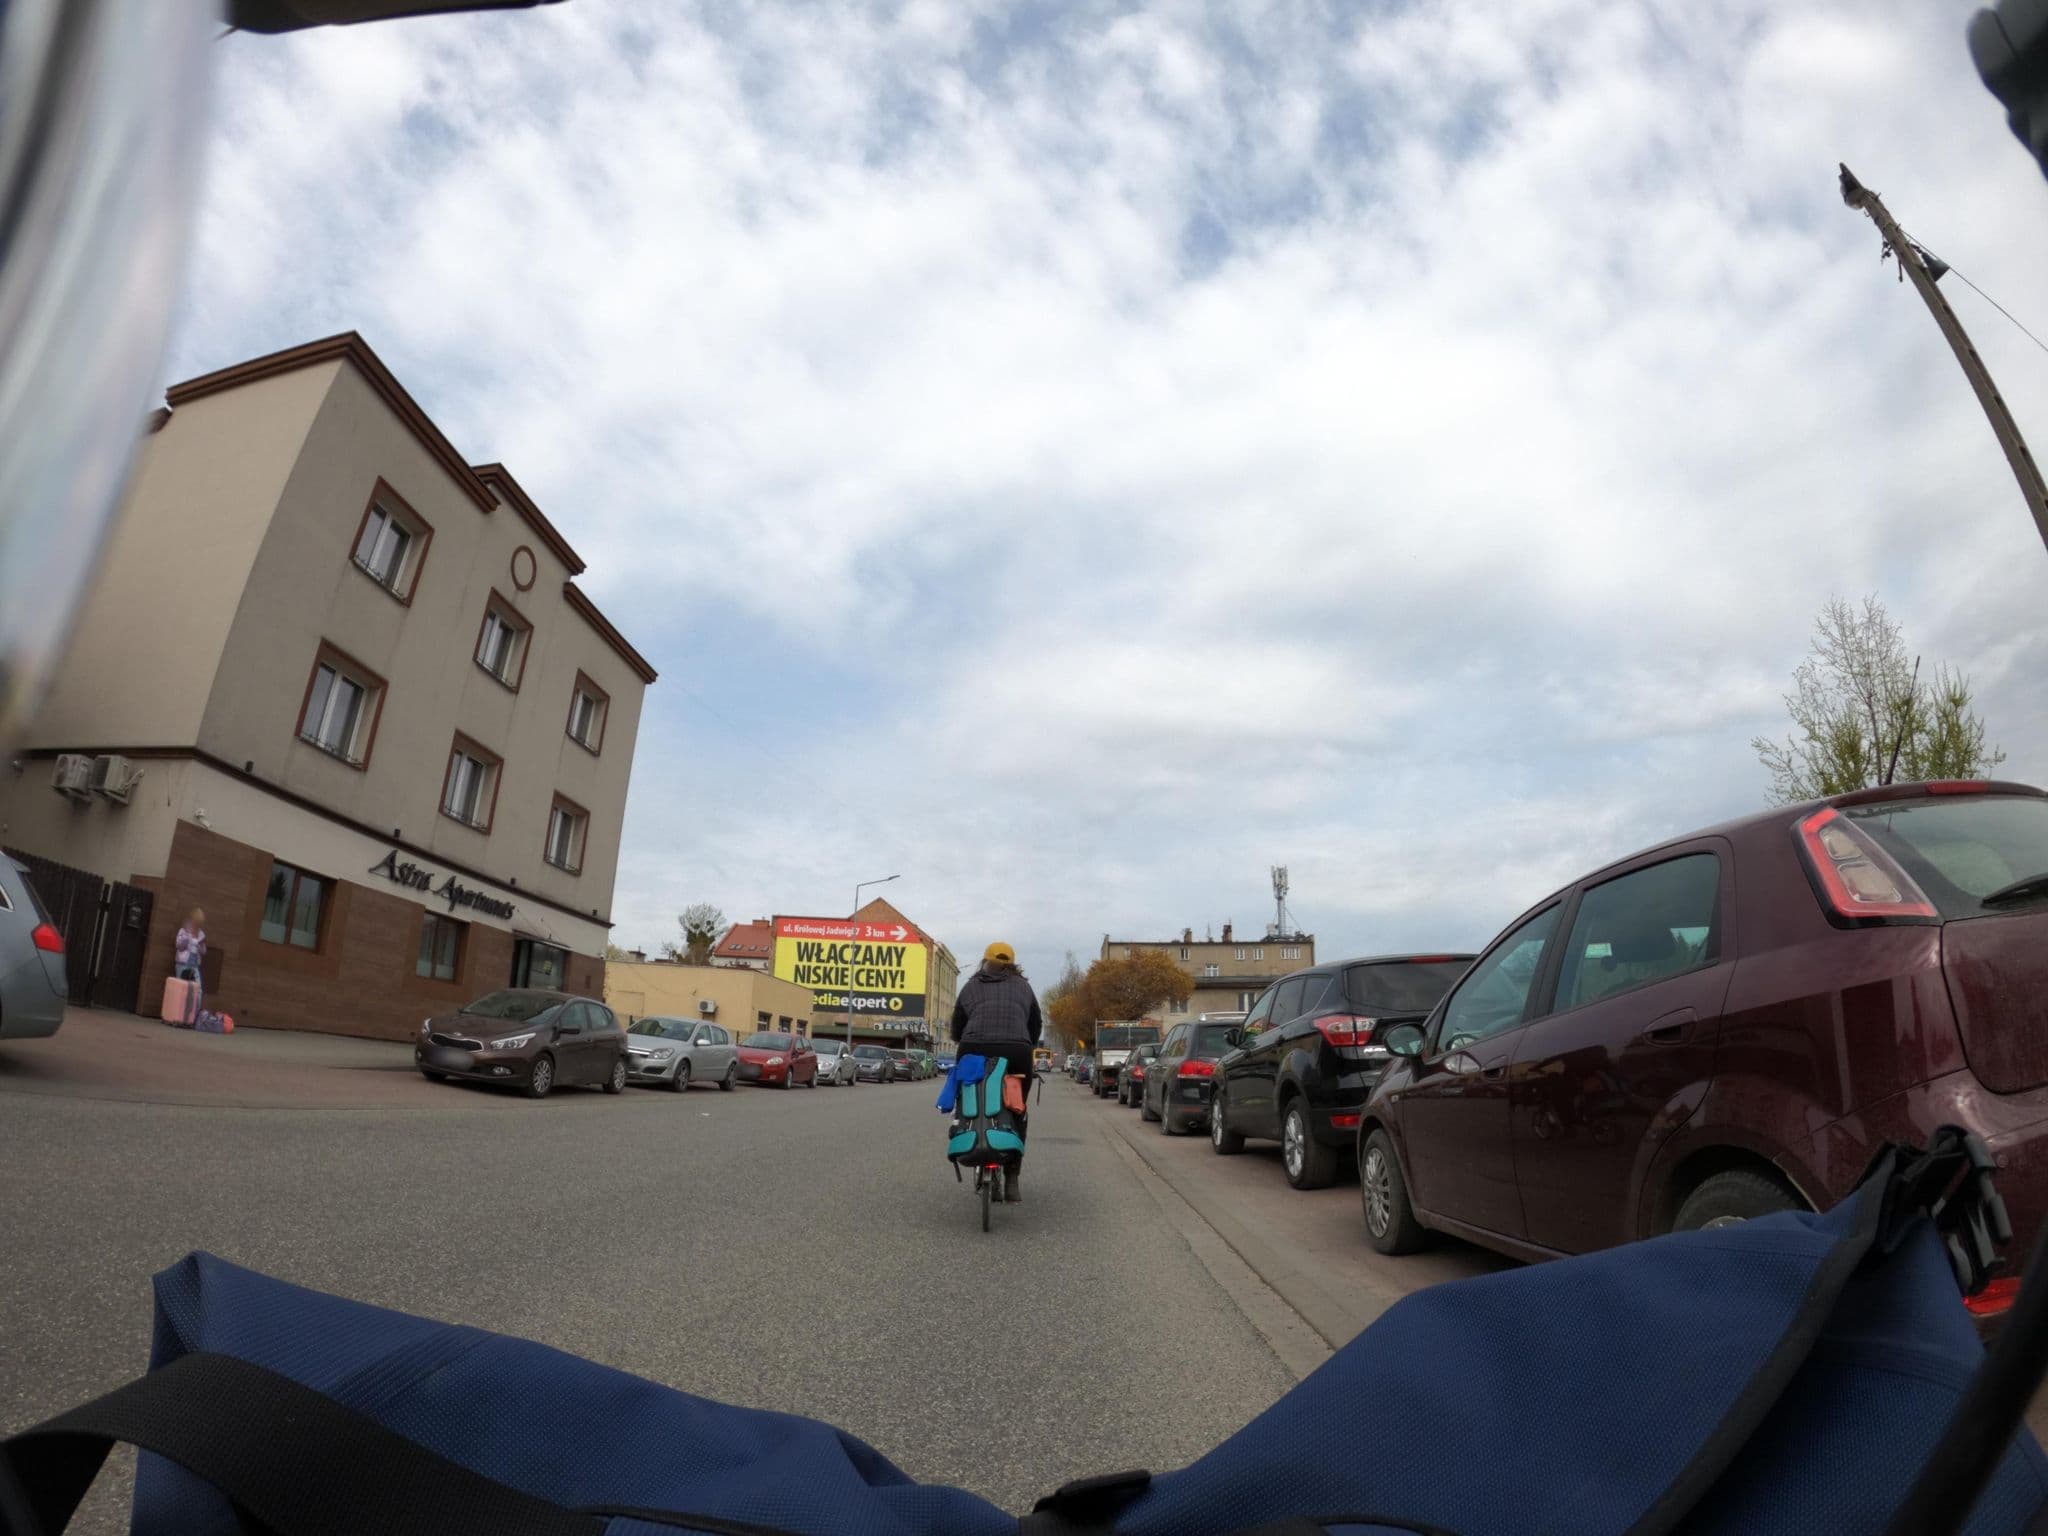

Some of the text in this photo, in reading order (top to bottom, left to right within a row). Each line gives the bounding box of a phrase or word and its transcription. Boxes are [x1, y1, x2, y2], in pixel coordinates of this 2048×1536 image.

[783, 923, 794, 933] ul.
[794, 924, 826, 936] Królowej
[865, 925, 872, 937] 3
[873, 929, 885, 937] km
[796, 941, 906, 967] WŁĄCZAMY
[793, 964, 905, 989] NISKIE CENY!
